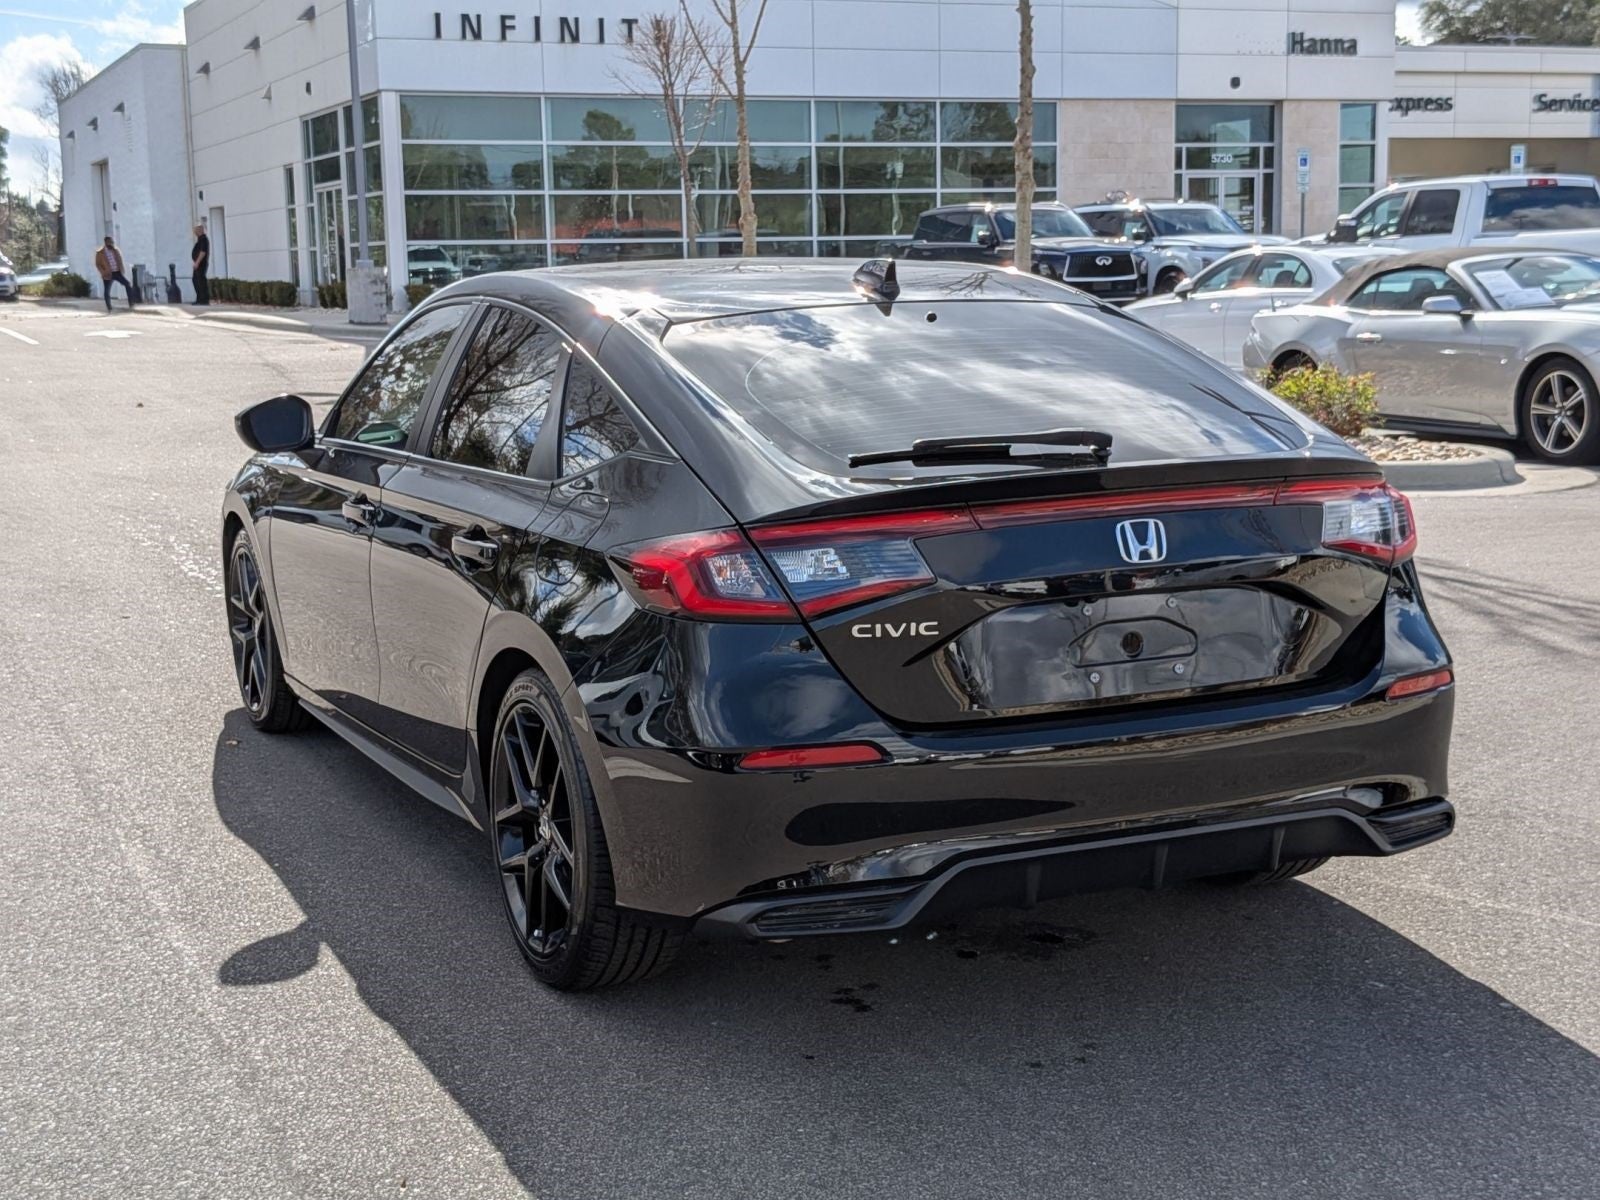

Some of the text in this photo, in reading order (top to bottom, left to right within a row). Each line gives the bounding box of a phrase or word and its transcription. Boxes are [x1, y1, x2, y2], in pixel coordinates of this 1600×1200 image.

[1287, 31, 1357, 56] Hanna
[1388, 96, 1453, 117] xpress
[1532, 93, 1600, 112] Service
[1211, 153, 1233, 163] 5730
[851, 621, 939, 638] CIVIC
